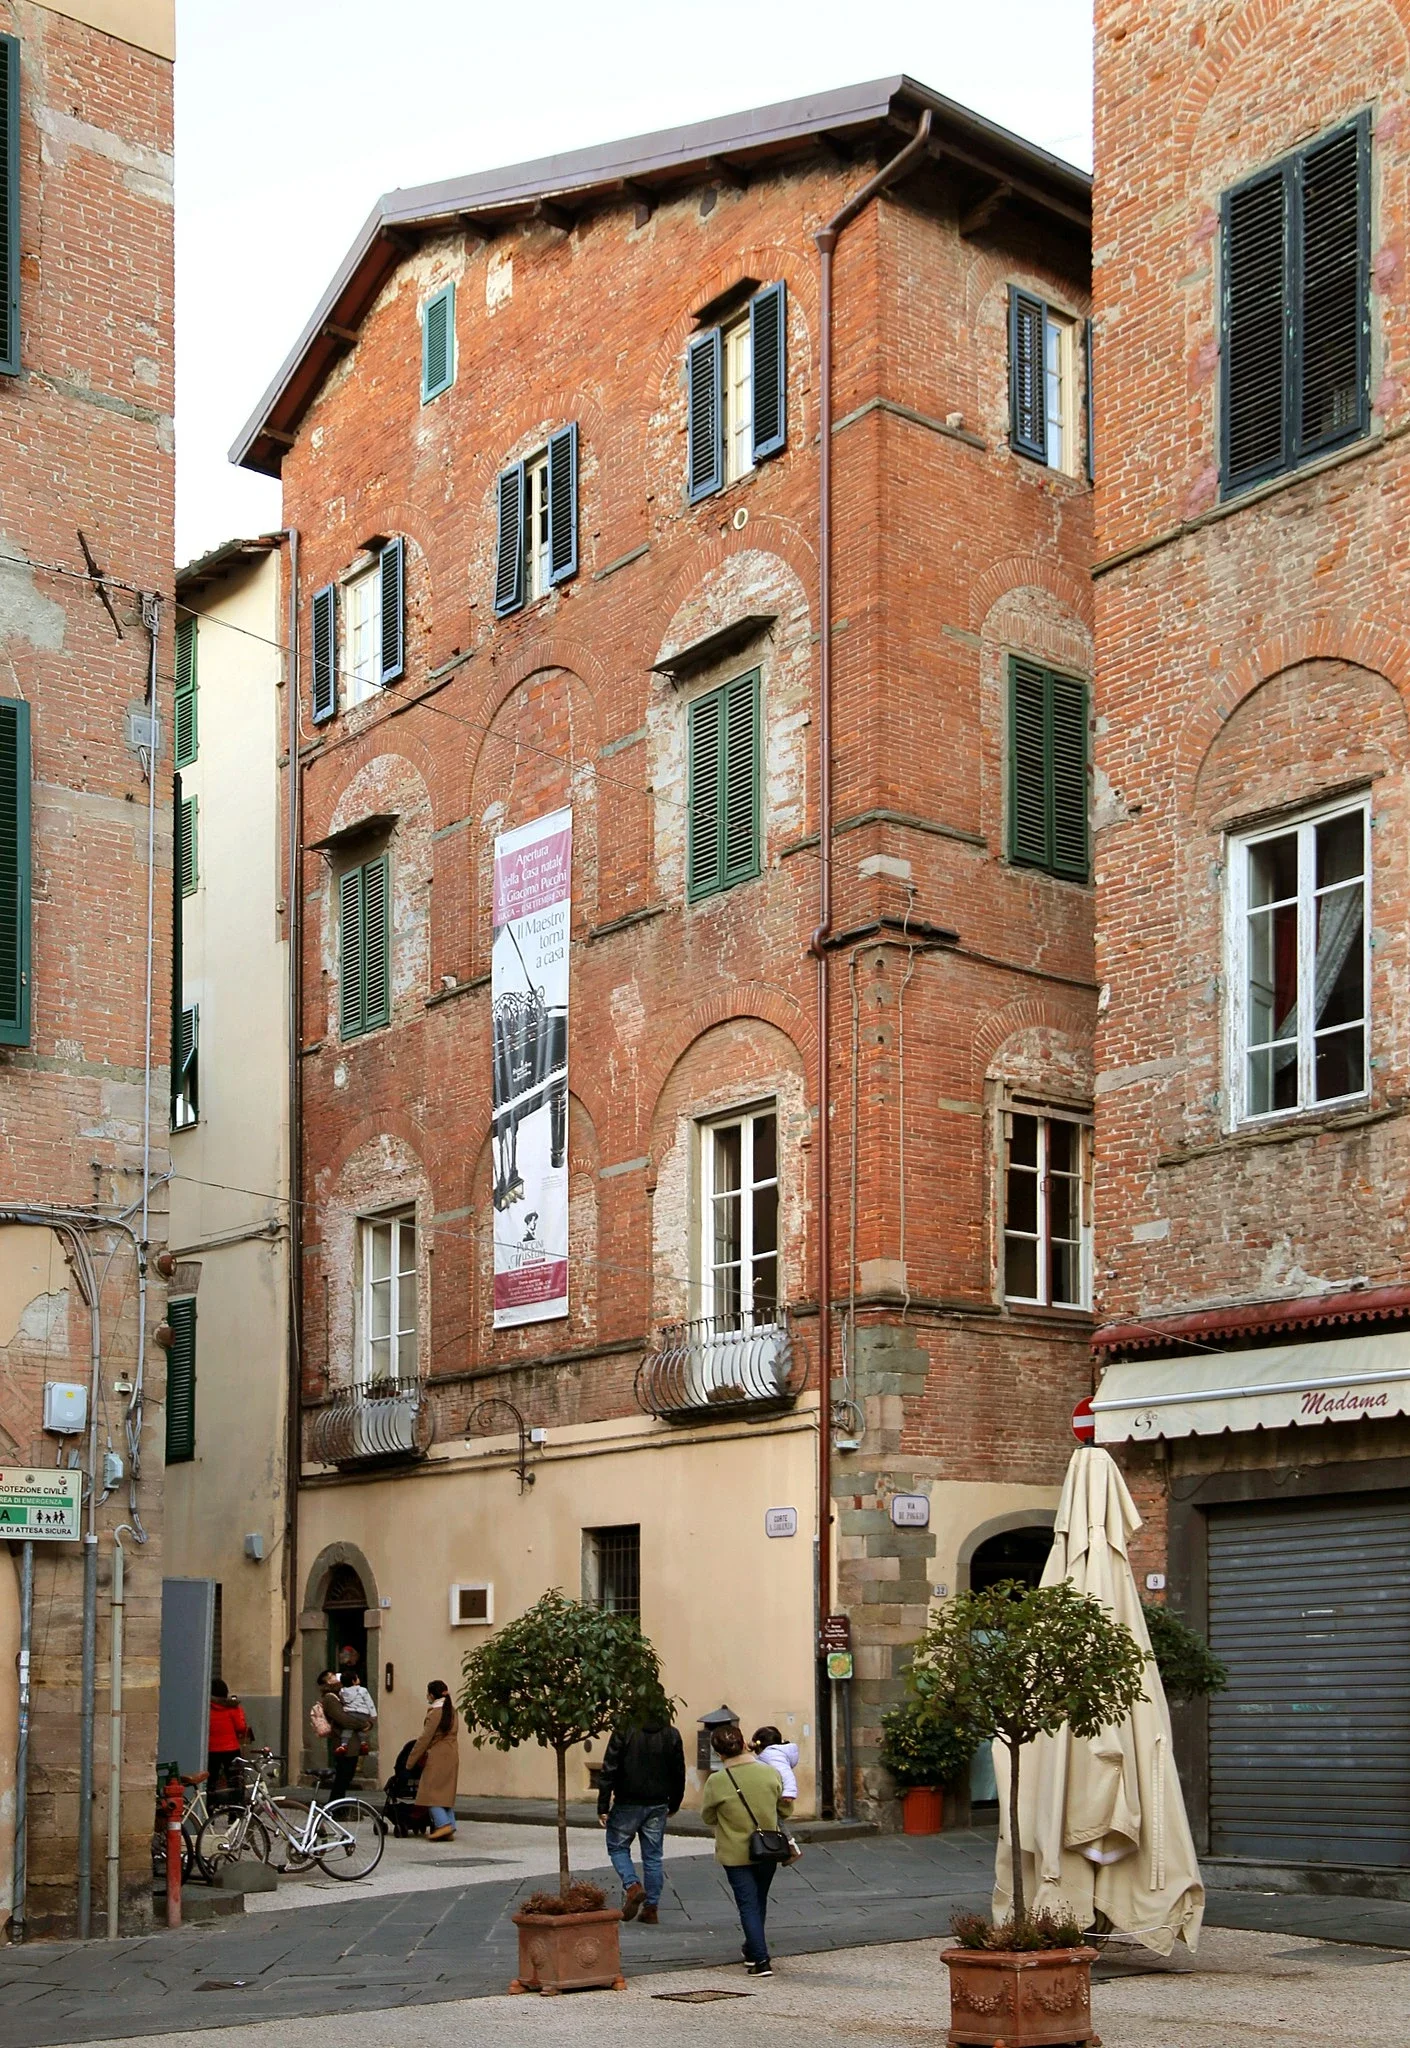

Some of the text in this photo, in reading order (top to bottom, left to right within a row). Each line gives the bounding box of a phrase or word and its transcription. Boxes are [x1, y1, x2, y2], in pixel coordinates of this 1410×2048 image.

[516, 845, 549, 868] Apertura
[503, 854, 563, 888] della Casa natale
[507, 884, 539, 902] Giacomo
[540, 869, 567, 891] Puccini
[517, 911, 565, 940] Il Maestro
[540, 929, 564, 949] torna
[536, 947, 564, 968] a casa
[1301, 1391, 1389, 1415] Madama
[43, 1487, 67, 1495] CIVILE
[22, 1498, 63, 1506] EMERGENZA
[15, 1526, 43, 1534] ATTESA
[1152, 1575, 1159, 1587] 9
